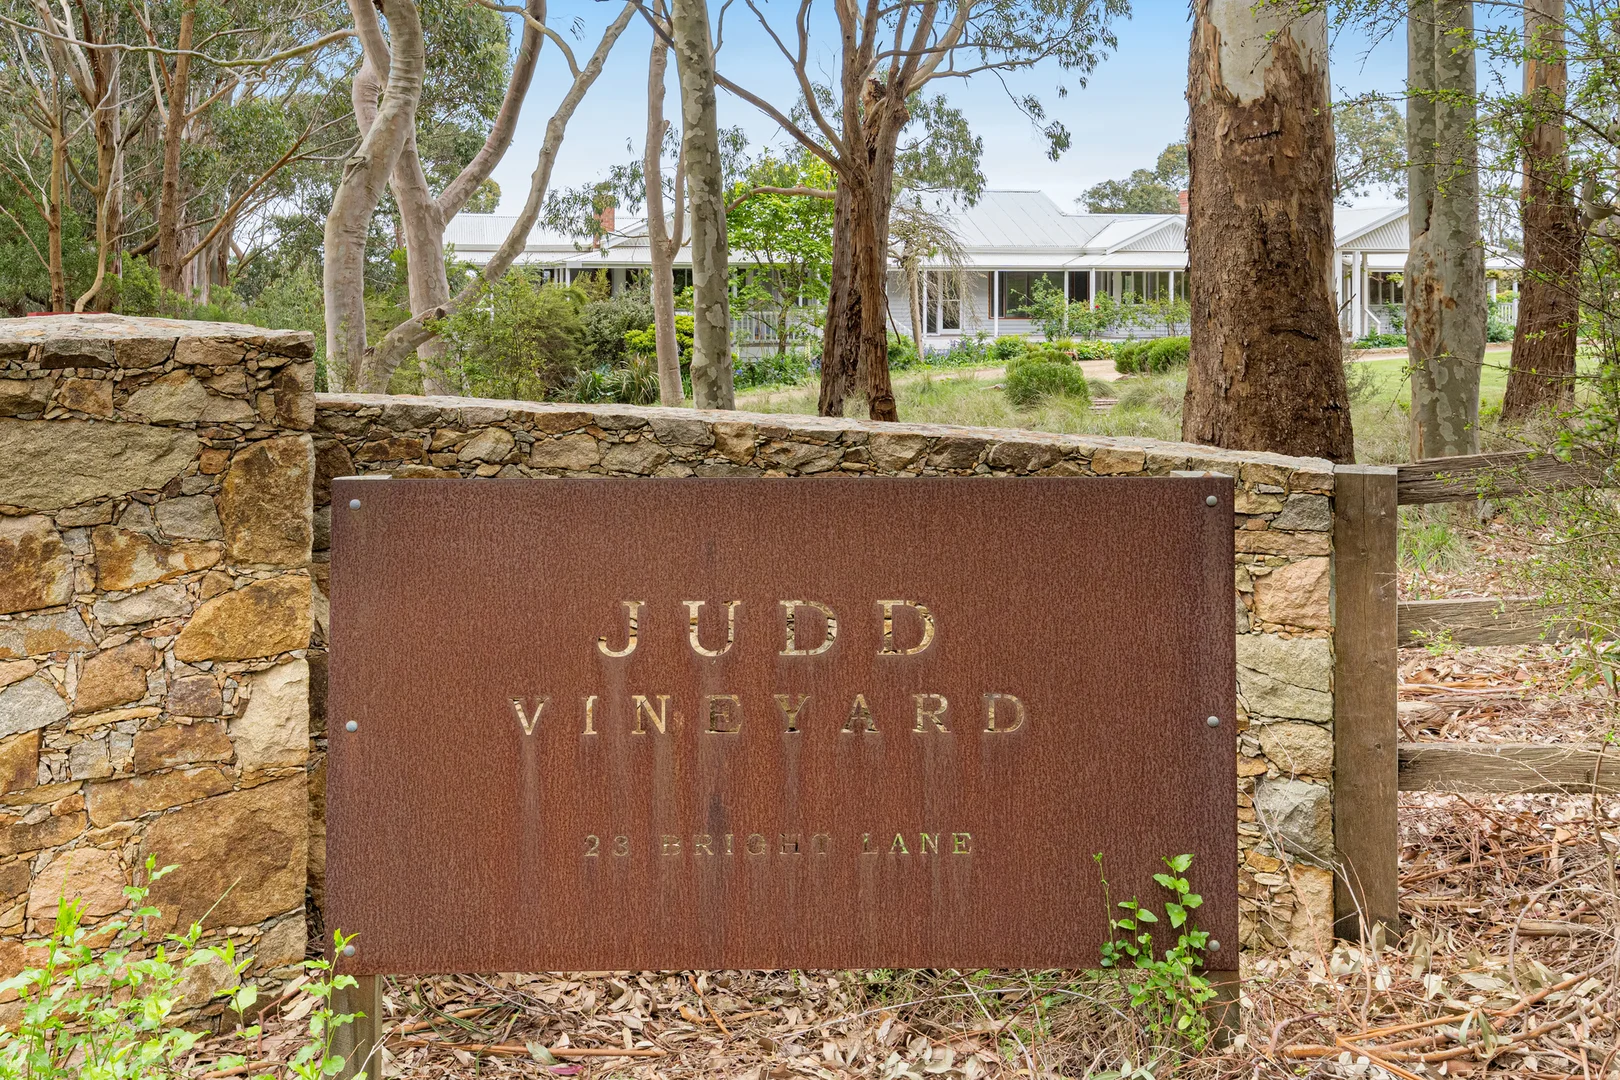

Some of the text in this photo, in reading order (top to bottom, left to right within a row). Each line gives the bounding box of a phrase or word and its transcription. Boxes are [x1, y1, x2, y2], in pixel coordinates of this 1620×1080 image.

[598, 600, 935, 657] JUDD
[508, 693, 1025, 736] VINEYARD
[584, 832, 972, 857] 23 BRIGHT LANE
